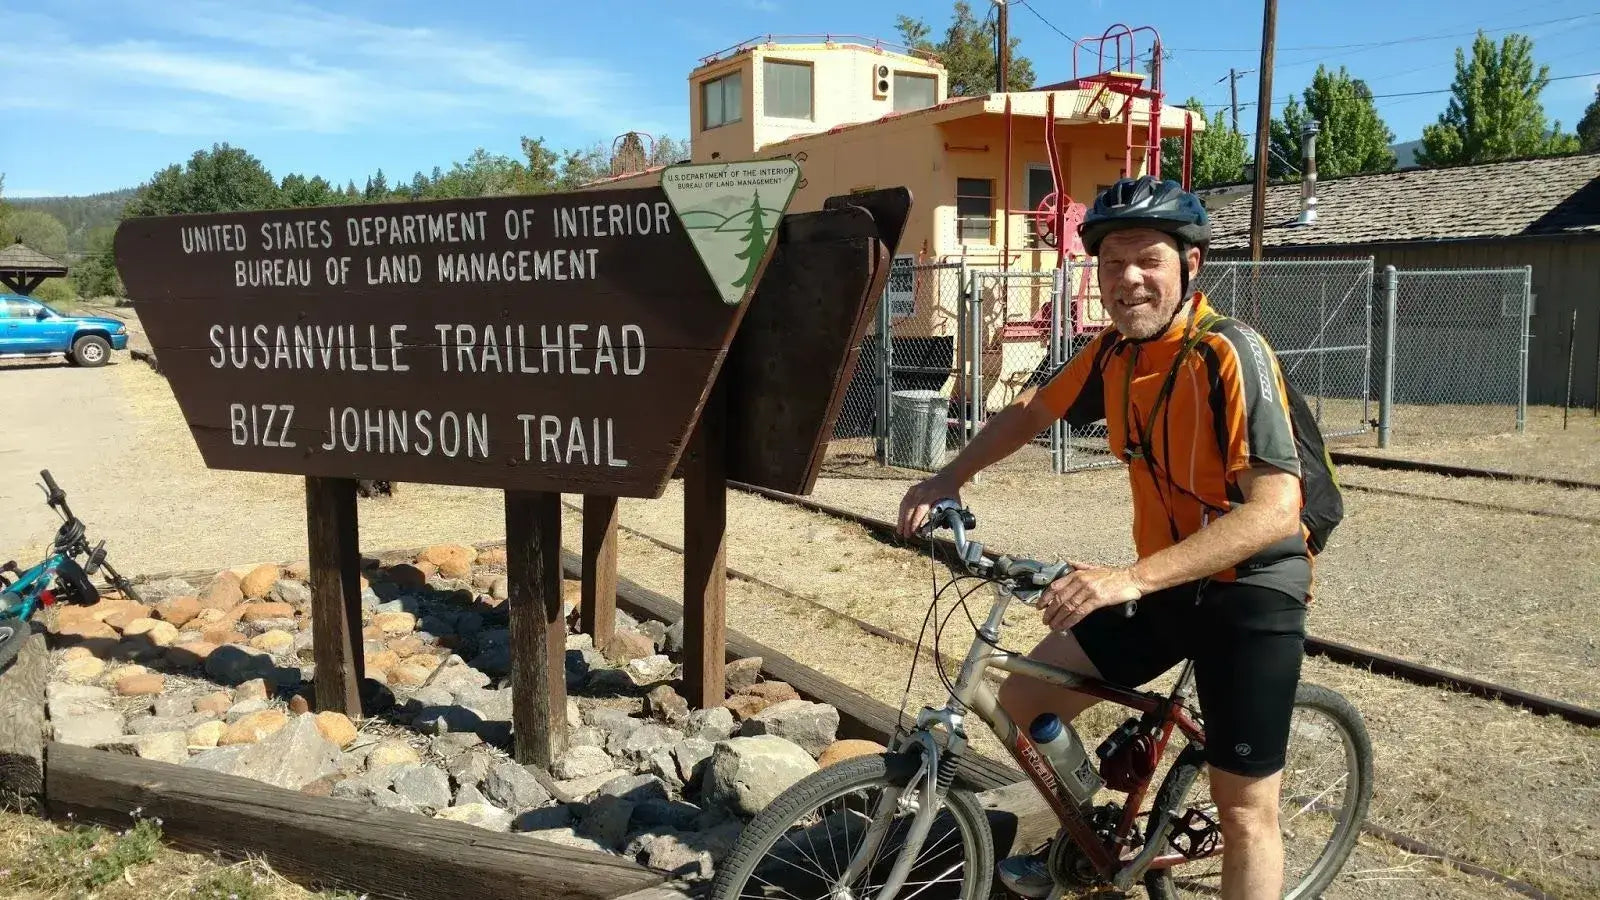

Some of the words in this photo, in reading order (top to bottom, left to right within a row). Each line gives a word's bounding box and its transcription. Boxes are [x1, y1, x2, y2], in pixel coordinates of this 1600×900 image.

[677, 182, 703, 190] BUREAU
[716, 180, 735, 188] LAND
[737, 178, 782, 186] MANAGEMENT
[681, 171, 728, 181] DEPARTMENT
[730, 170, 740, 178] OF
[742, 169, 757, 177] THE
[180, 223, 247, 254] UNITED
[260, 219, 333, 251] STATES
[347, 212, 487, 247] DEPARTMENT
[504, 208, 535, 241] OF
[553, 202, 671, 238] INTERIOR
[235, 258, 311, 287] BUREAU
[326, 256, 352, 285] OF
[366, 253, 422, 285] LAND
[437, 248, 600, 283] MANAGEMENT
[209, 323, 410, 372] SUSANVILLE
[434, 323, 647, 376] TRAILHEAD
[230, 403, 297, 448] BIZZ
[321, 406, 490, 458] JOHNSON
[516, 413, 629, 468] TRAIL
